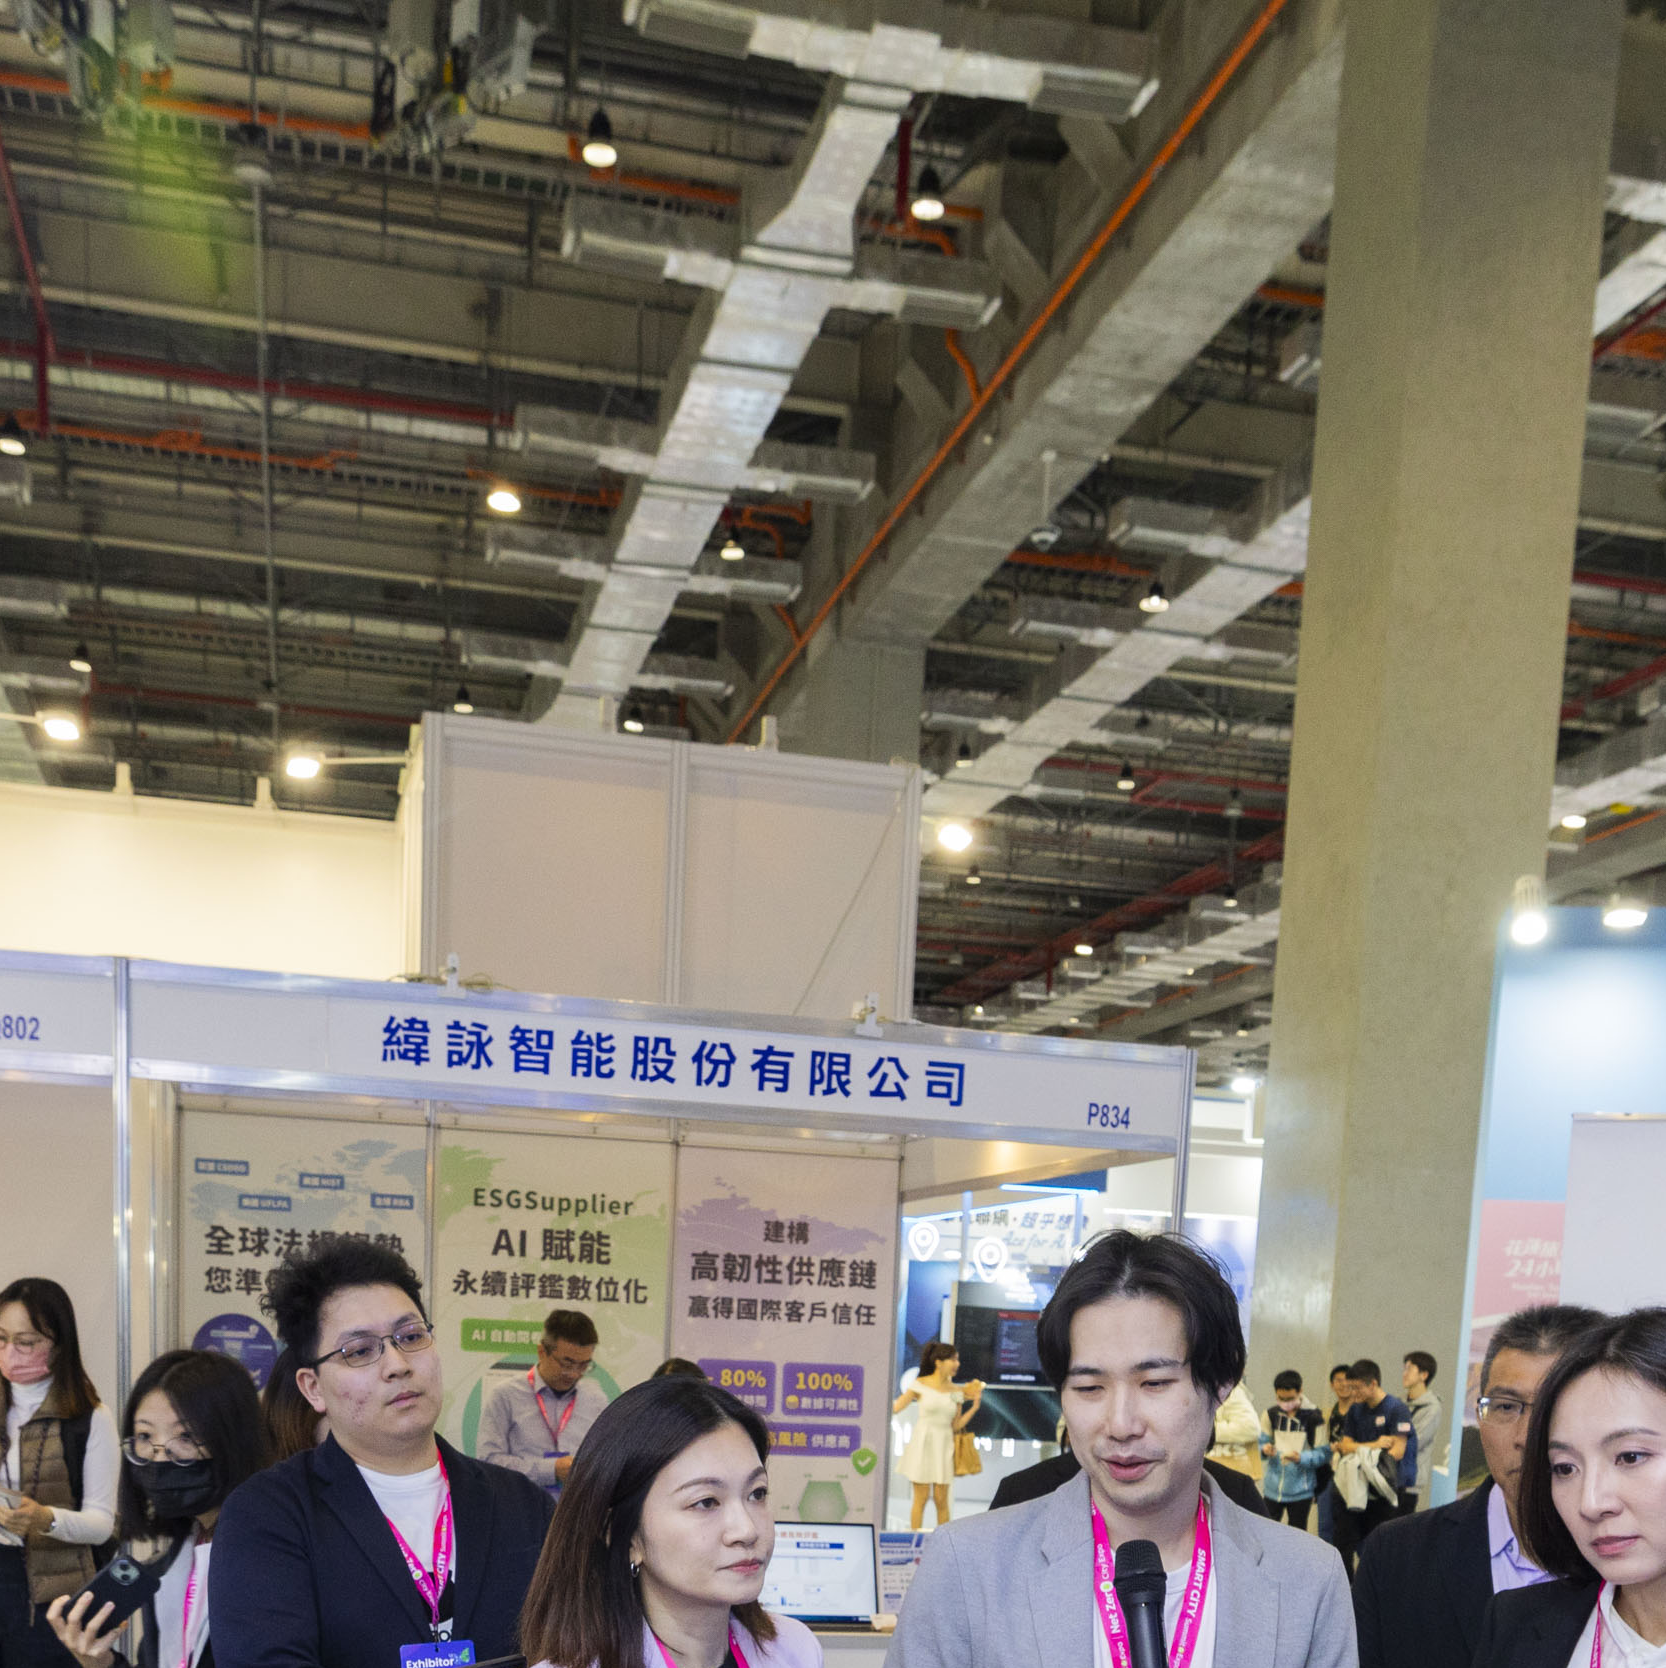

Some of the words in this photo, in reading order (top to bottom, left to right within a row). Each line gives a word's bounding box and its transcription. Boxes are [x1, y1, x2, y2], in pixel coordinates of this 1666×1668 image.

[380, 1013, 967, 1108] 緯詠智能股份有限公司
[1086, 1102, 1132, 1131] P834
[472, 1187, 635, 1218] ESGSupplier
[491, 1228, 527, 1258] AI
[540, 1228, 612, 1266] 賦能
[763, 1219, 811, 1246] 建構
[690, 1250, 878, 1290] 高韌性供應鏈
[452, 1268, 649, 1305] 永續評鑑數位化
[686, 1295, 877, 1327] 贏得國際客戶信任
[719, 1368, 768, 1389] 80%
[794, 1371, 855, 1392] 100%
[1096, 1543, 1106, 1563] Expo
[1192, 1547, 1207, 1589] SMART
[1186, 1589, 1202, 1619] CITY
[1110, 1612, 1122, 1634] Net
